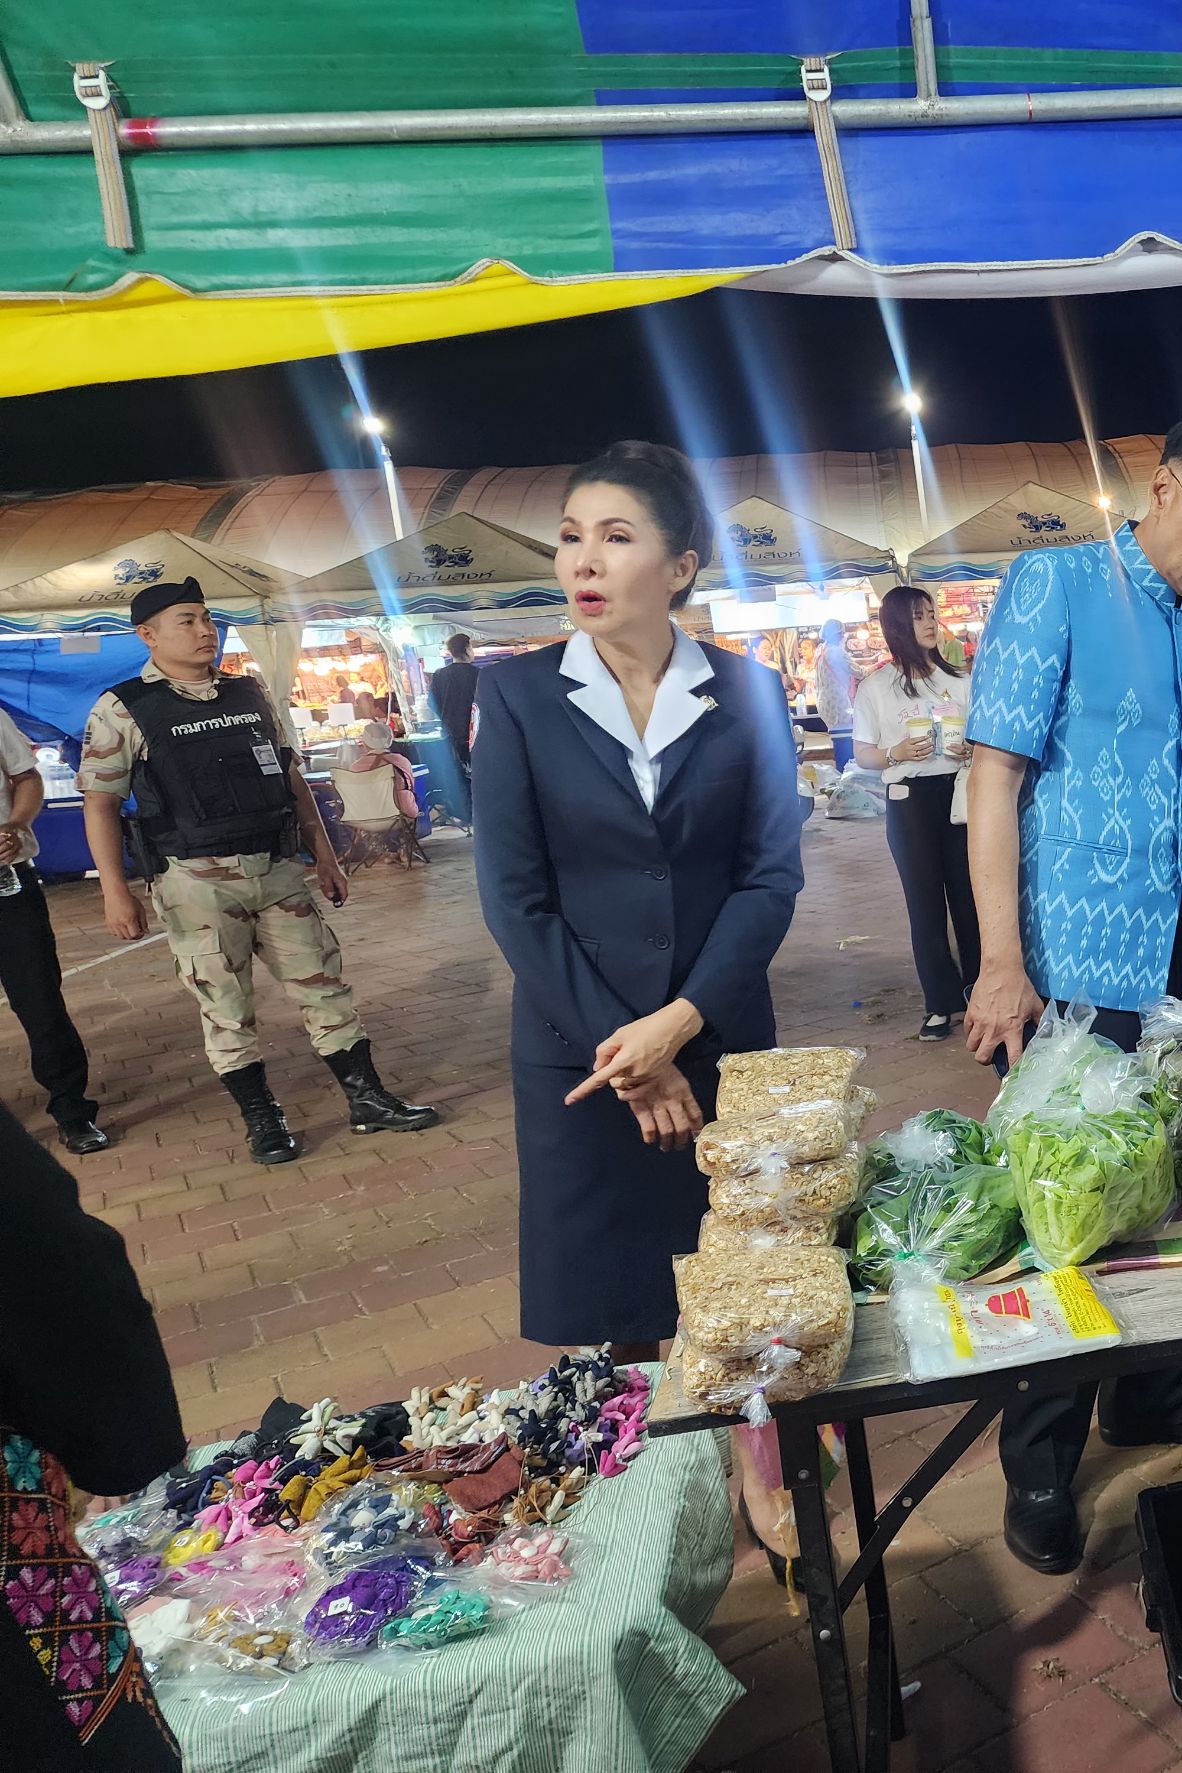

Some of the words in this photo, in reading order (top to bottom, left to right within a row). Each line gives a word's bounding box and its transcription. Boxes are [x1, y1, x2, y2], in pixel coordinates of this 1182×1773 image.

[171, 712, 262, 737] กรมการปกครอง
